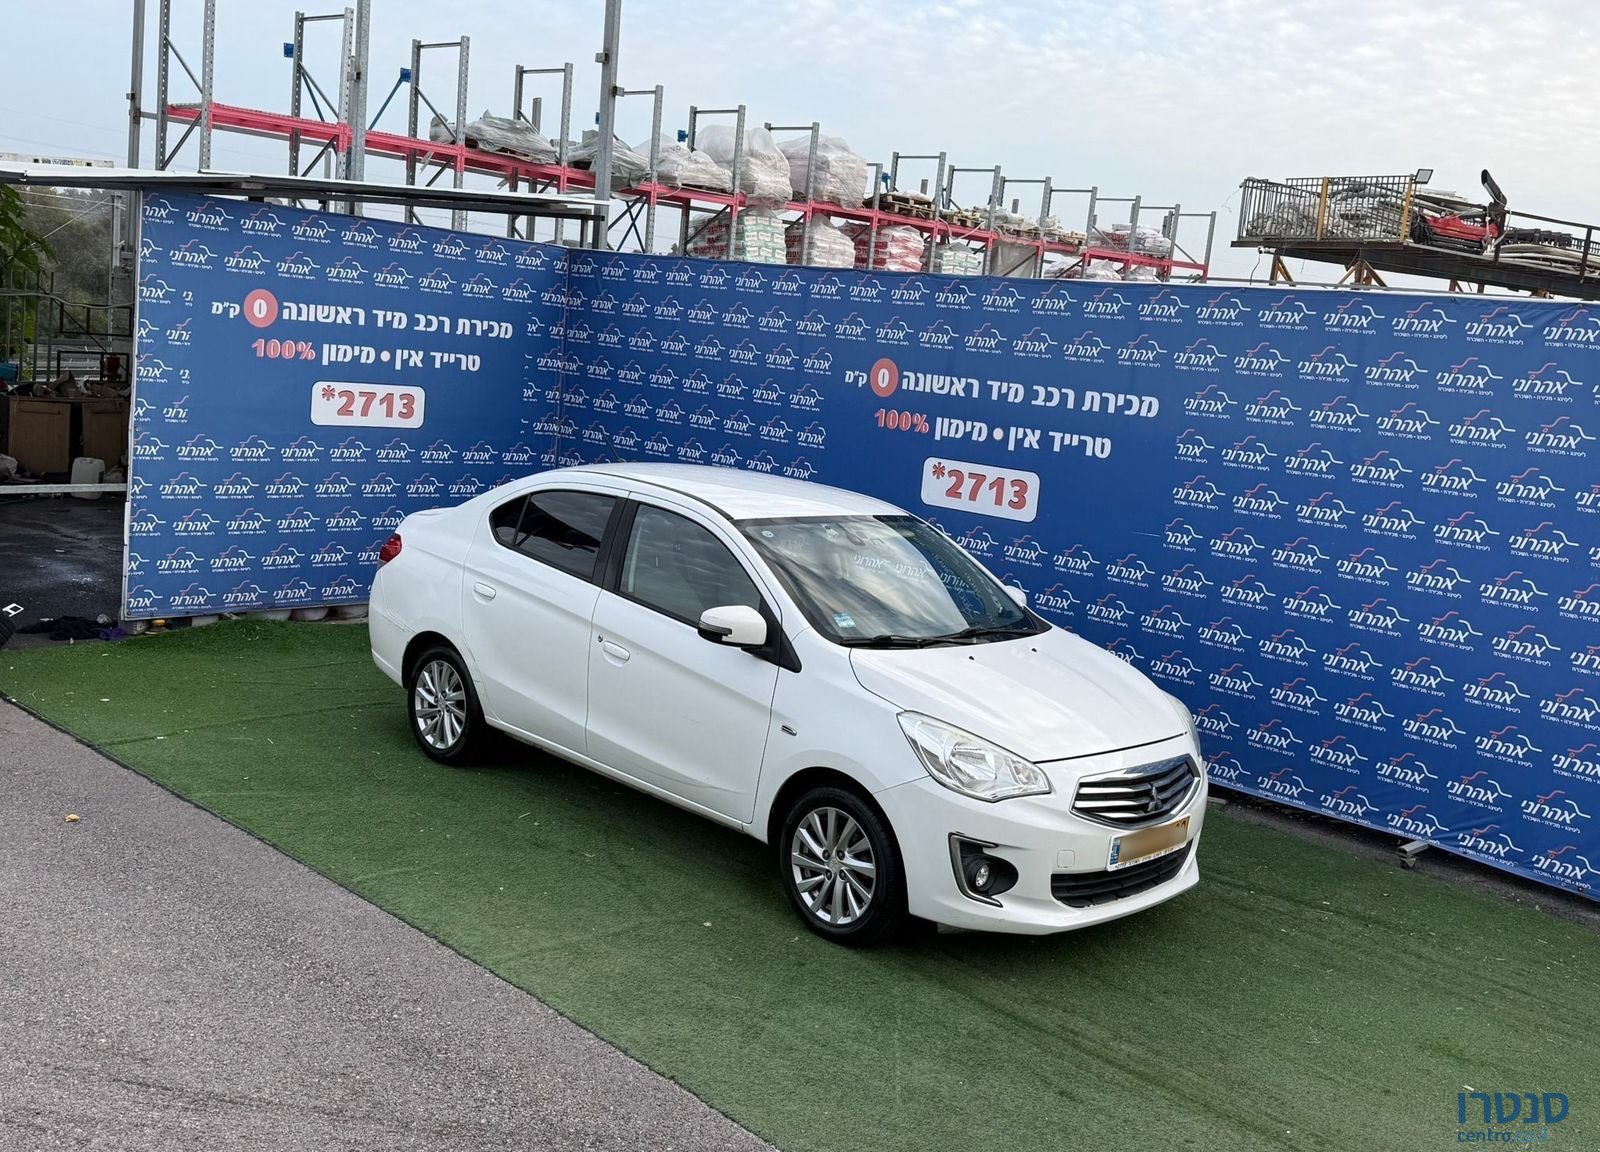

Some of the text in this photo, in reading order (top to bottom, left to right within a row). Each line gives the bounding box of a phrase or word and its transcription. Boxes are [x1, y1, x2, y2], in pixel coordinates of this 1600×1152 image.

[186, 212, 224, 225] אהרוני
[241, 219, 276, 231] אהרוני
[292, 226, 326, 237] אהרוני
[170, 251, 208, 263] אהרוני
[224, 257, 261, 269] אהרוני
[475, 250, 503, 260] אהרוני
[374, 273, 405, 284] אהרוני
[735, 278, 760, 288] אהרוני
[502, 288, 529, 298] אהרוני
[891, 290, 921, 300] אהרוני
[254, 300, 266, 317] 0
[283, 302, 365, 325] ראשונה
[622, 303, 644, 313] אהרוני
[1083, 302, 1121, 313] אהרוני
[1138, 304, 1178, 316] אהרוני
[1196, 308, 1238, 319] אהרוני
[373, 310, 407, 329] מיד
[414, 314, 450, 333] רכב
[759, 317, 784, 328] אהרוני
[1324, 314, 1371, 327] אהרוני
[1392, 318, 1442, 331] אהרוני
[456, 319, 512, 338] מכירת
[876, 328, 905, 339] אהרוני
[1465, 323, 1518, 337] אהרוני
[661, 341, 684, 351] אהרוני
[1064, 344, 1100, 356] אהרוני
[252, 339, 480, 371] טרייד אין מימון 100%
[1117, 349, 1156, 360] אהרוני
[803, 359, 830, 369] אהרוני
[1234, 357, 1278, 370] אהרוני
[1298, 362, 1344, 375] אהרוני
[878, 369, 889, 387] 0
[1365, 367, 1414, 381] אהרוני
[1436, 373, 1488, 388] אהרוני
[717, 384, 741, 395] אהרוני
[902, 372, 979, 398] ראשונה
[987, 381, 1024, 403] מיד
[1513, 379, 1567, 394] אהרוני
[1032, 386, 1074, 408] רכב
[1082, 391, 1159, 417] מכירת
[656, 409, 679, 419] אהרוני
[1245, 404, 1289, 418] אהרוני
[1309, 410, 1355, 425] אהרוני
[760, 426, 785, 437] אהרוני
[1377, 417, 1426, 432] אהרוני
[1449, 424, 1501, 440] אהרוני
[874, 408, 1111, 458] טרייד אין מימון 100%
[1525, 432, 1581, 448] אהרוני
[177, 447, 214, 456] אהרוני
[421, 451, 450, 459] אהרוני
[677, 447, 701, 458] אהרוני
[1285, 457, 1330, 471] אהרוני
[1351, 464, 1398, 480] אהרוני
[160, 485, 197, 494] אהרוני
[214, 485, 250, 494] אהרוני
[315, 484, 347, 492] אהרוני
[1421, 473, 1472, 490] אהרוני
[1173, 488, 1213, 502] אהרוני
[1496, 482, 1550, 499] אהרוני
[1296, 505, 1342, 521] אהרוני
[173, 522, 210, 530] אהרוני
[226, 521, 262, 529] אהרוני
[277, 519, 311, 528] אהרוני
[1362, 515, 1411, 531] אהרוני
[1433, 525, 1485, 542] אהרוני
[1210, 539, 1252, 555] אהרוני
[1509, 536, 1564, 554] אהרוני
[157, 560, 194, 569] אהרוני
[1106, 565, 1144, 580] אהרוני
[1337, 560, 1384, 577] אהרוני
[1162, 575, 1202, 591] אהרוני
[1406, 572, 1456, 590] אהרוני
[170, 596, 207, 605] אהרוני
[223, 592, 258, 602] אהרוני
[274, 589, 307, 599] אהרוני
[1035, 593, 1070, 609] אהרוני
[1480, 584, 1533, 603] אהרוני
[1086, 604, 1123, 620] אהרוני
[1283, 598, 1328, 615] אהרוני
[1348, 610, 1396, 628] אהרוני
[1198, 627, 1239, 645] אהרוני
[1418, 623, 1468, 642] אהרוני
[1259, 640, 1303, 658] אהרוני
[1492, 637, 1546, 657] אהרוני
[1151, 660, 1190, 677] אהרוני
[1323, 654, 1369, 673] אהרוני
[1209, 674, 1251, 692] אהרוני
[1391, 668, 1440, 688] אהרוני
[1270, 688, 1314, 707] אהרוני
[1463, 684, 1515, 704] אהרוני
[1334, 703, 1381, 723] אהרוני
[1403, 719, 1452, 740] אהרוני
[1247, 729, 1290, 748] אהרוני
[1309, 745, 1355, 766] אהרוני
[1376, 763, 1424, 784] אהרוני
[1447, 781, 1498, 803] אהרוני
[1320, 795, 1366, 816] אהרוני
[1521, 800, 1575, 823] אהרוני
[1387, 814, 1435, 836] אהרוני
[1458, 833, 1509, 856] אהרוני
[1532, 855, 1586, 879] אהרוני
